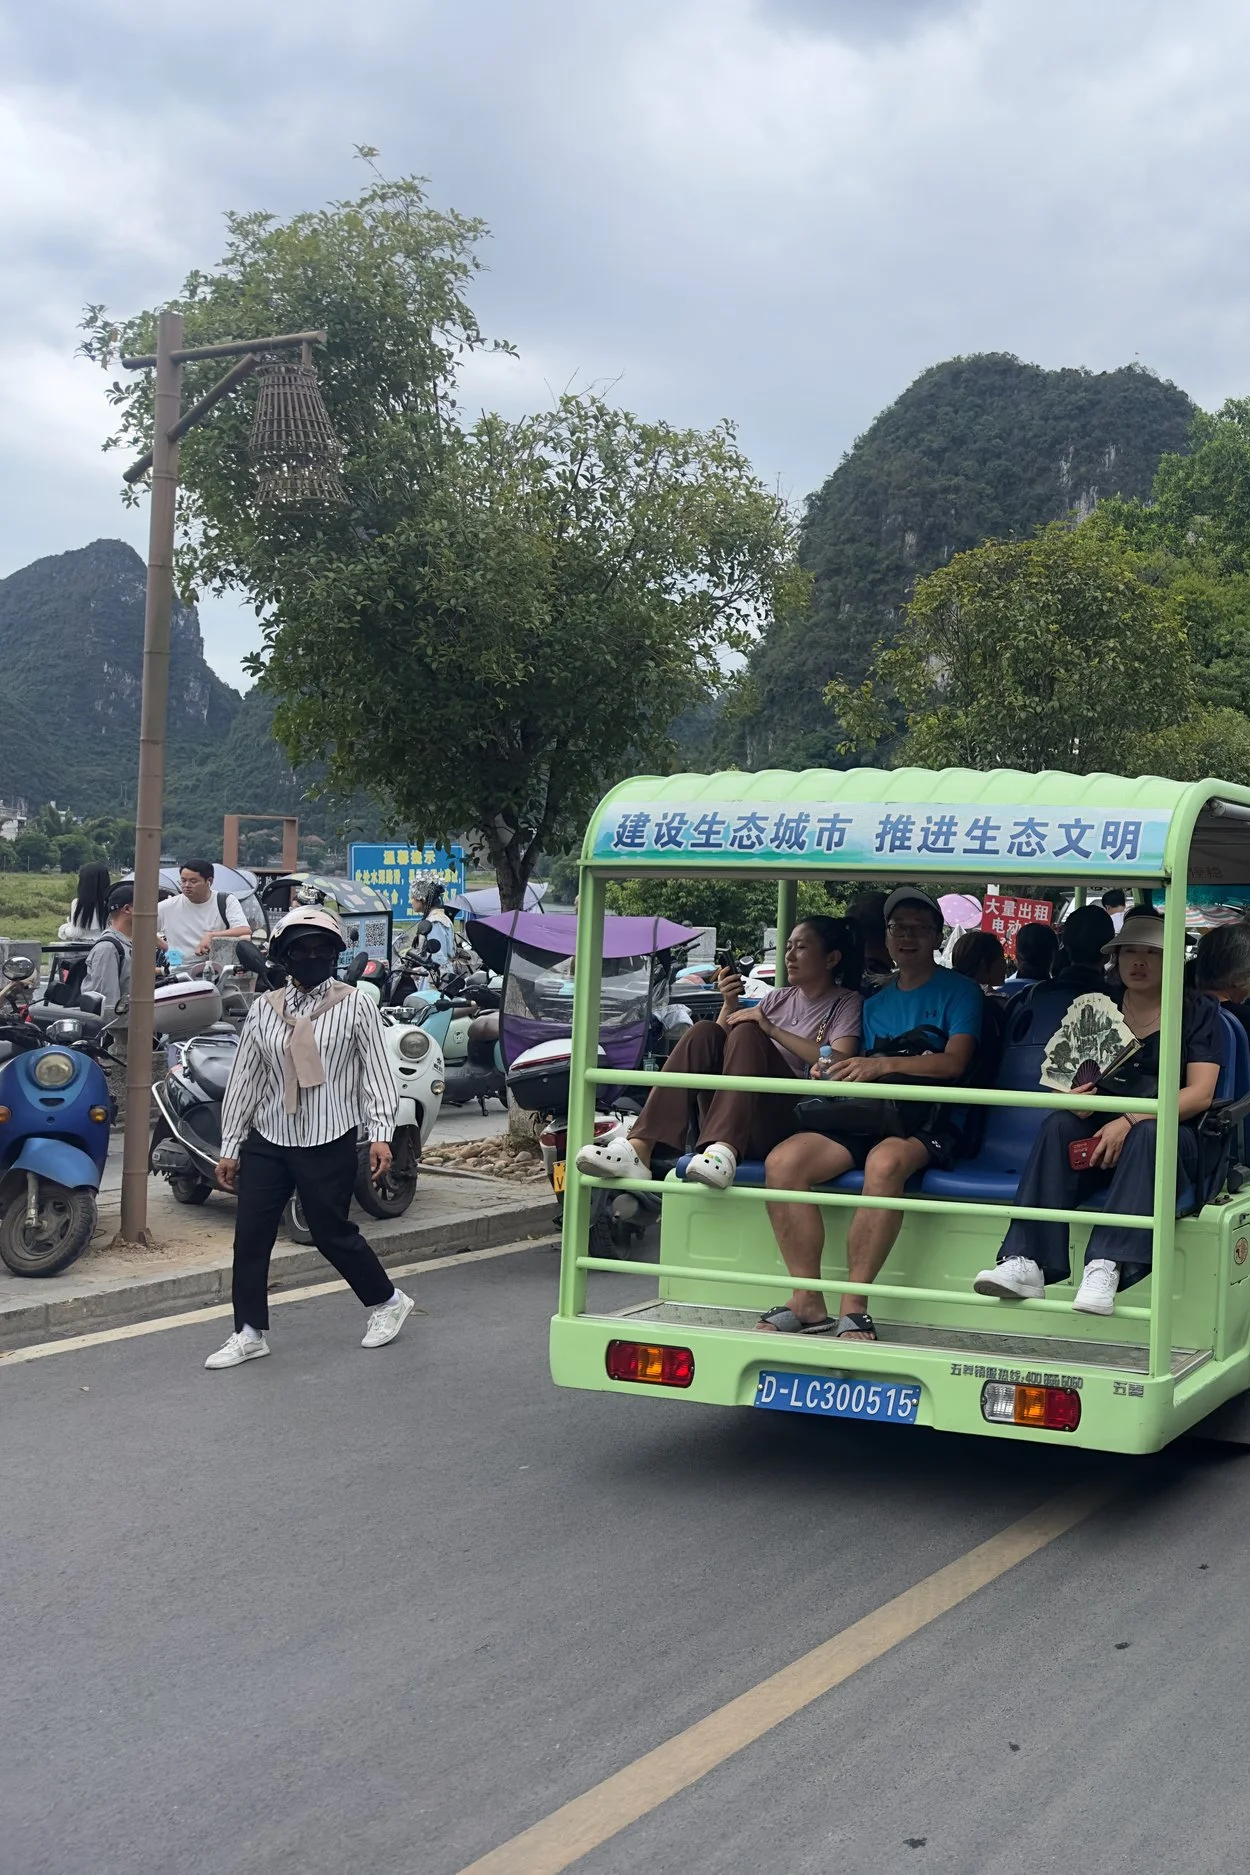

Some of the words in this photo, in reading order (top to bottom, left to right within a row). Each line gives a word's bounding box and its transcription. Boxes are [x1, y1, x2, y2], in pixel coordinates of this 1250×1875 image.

[613, 811, 853, 851] 建设生态城市
[874, 813, 1142, 861] 推进生态文明
[985, 898, 1049, 921] 大量出租
[992, 917, 1033, 935] 电动
[760, 1375, 914, 1417] D-LC300515
